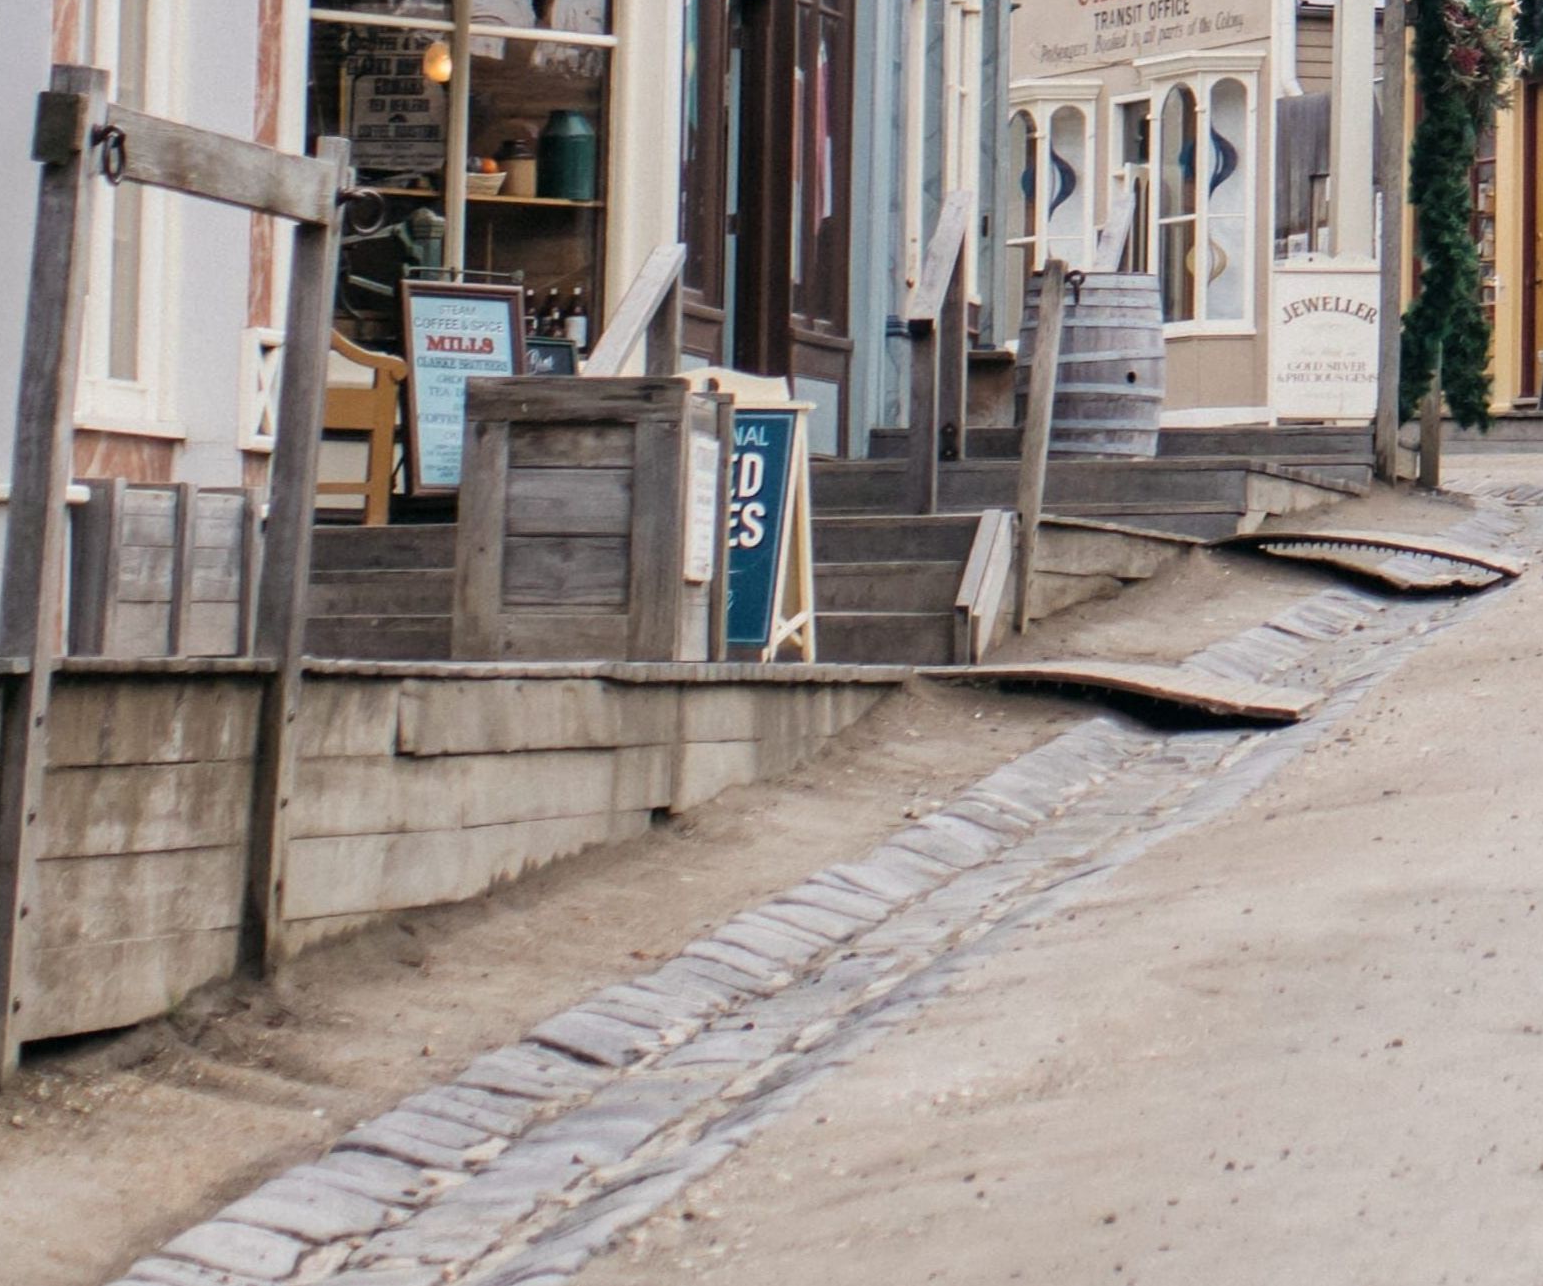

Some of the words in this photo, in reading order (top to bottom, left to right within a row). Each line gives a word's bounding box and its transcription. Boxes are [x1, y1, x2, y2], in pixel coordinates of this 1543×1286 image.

[1093, 3, 1143, 32] TRANSIT
[1282, 295, 1379, 325] JEWELLER
[413, 316, 459, 329] COFFEE
[470, 320, 505, 333] SPICE
[424, 334, 495, 355] MILLS
[416, 355, 457, 370] CLARKE
[458, 358, 508, 373] BROTHERS
